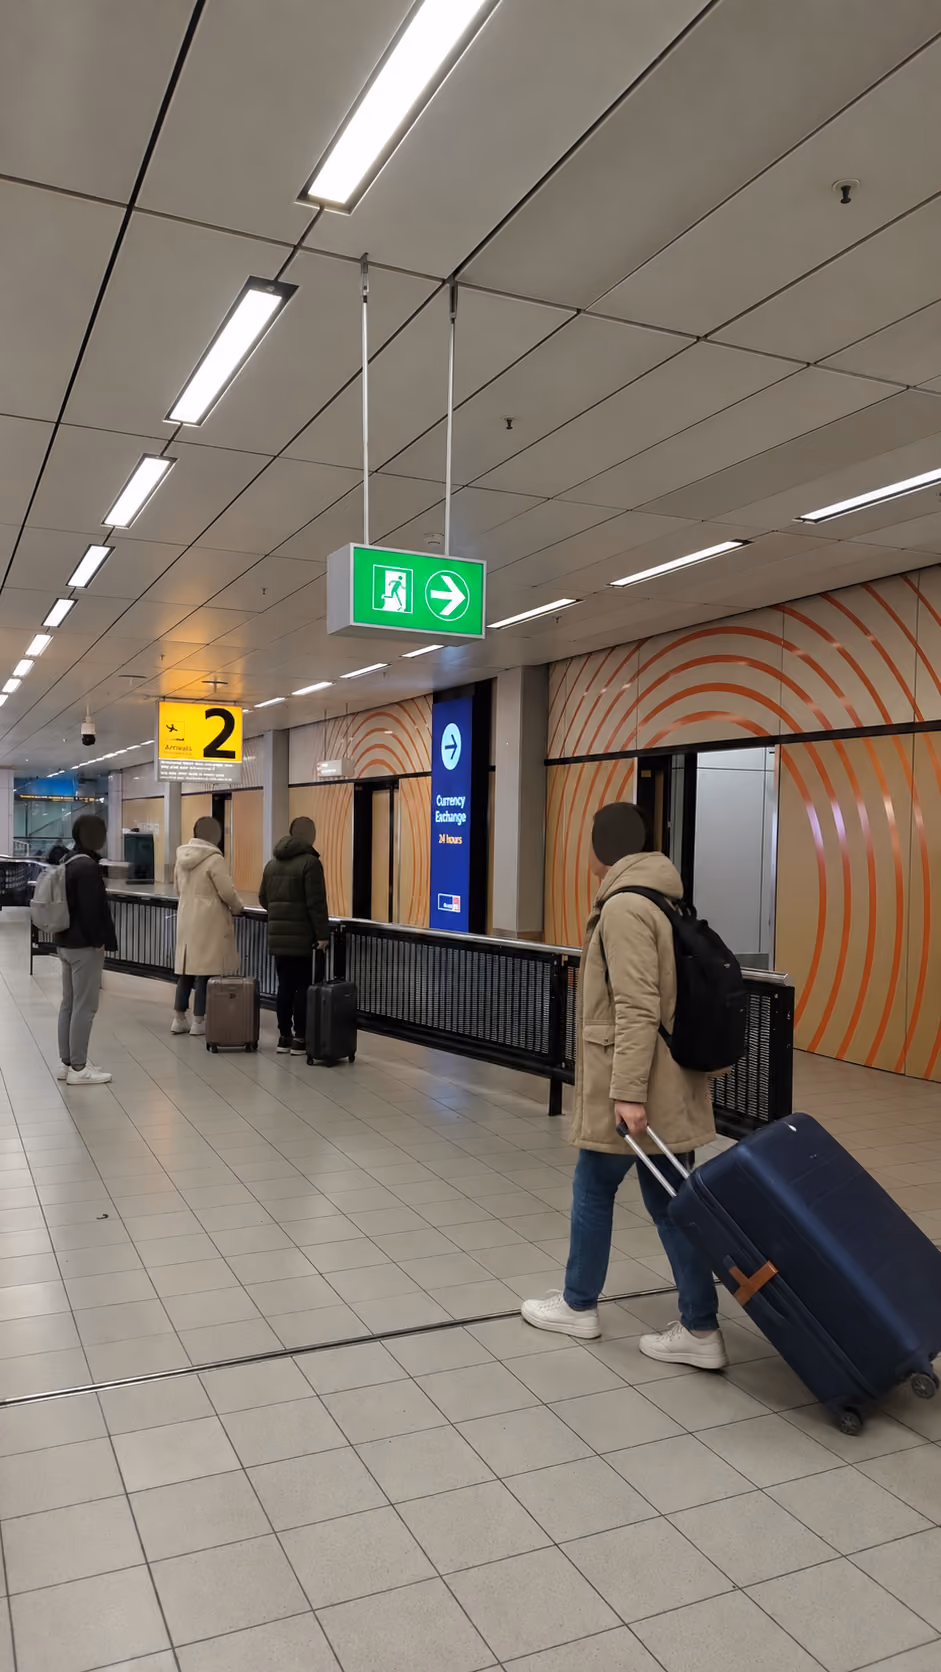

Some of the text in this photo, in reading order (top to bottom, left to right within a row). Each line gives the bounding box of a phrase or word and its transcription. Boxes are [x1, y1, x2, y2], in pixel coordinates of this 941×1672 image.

[203, 708, 236, 759] 2
[436, 794, 466, 809] Currency
[435, 810, 467, 826] Exchange
[438, 833, 463, 844] 24 hours
